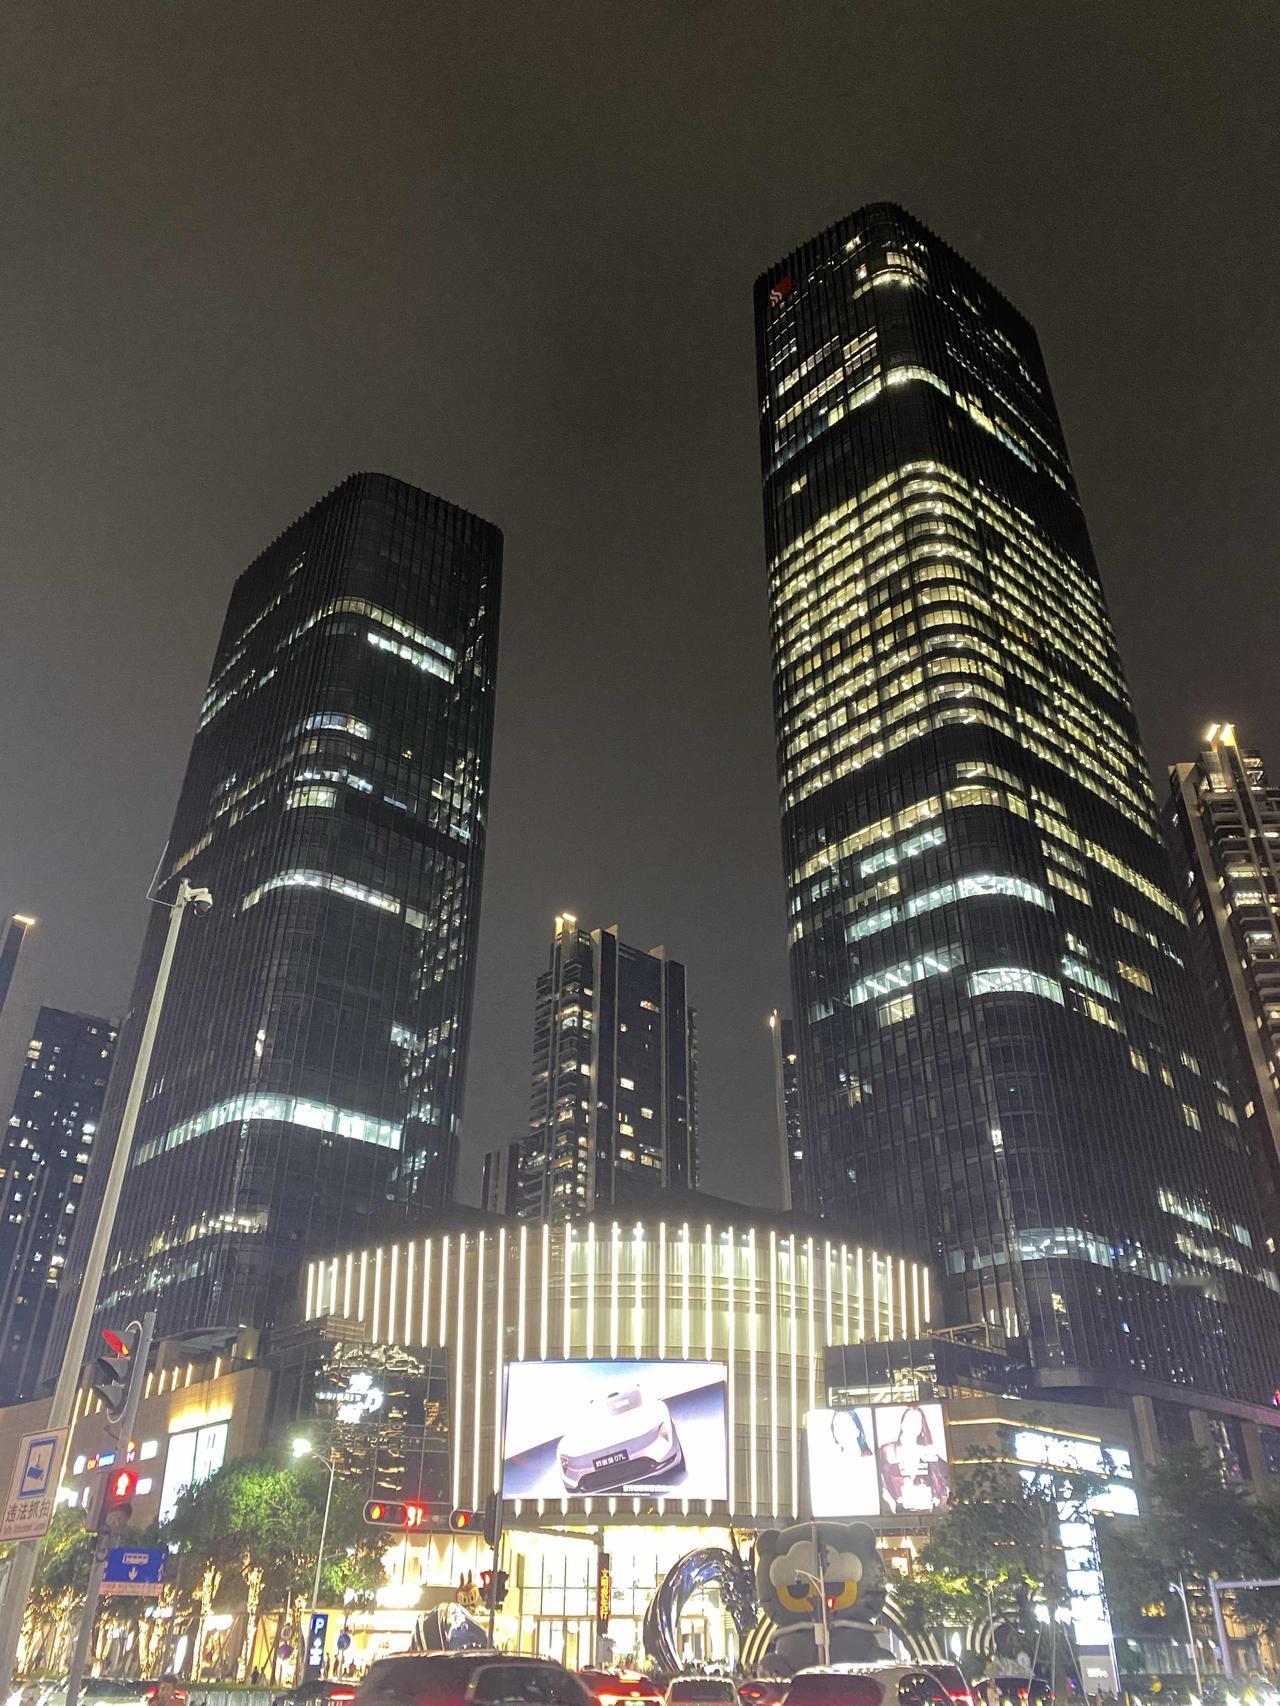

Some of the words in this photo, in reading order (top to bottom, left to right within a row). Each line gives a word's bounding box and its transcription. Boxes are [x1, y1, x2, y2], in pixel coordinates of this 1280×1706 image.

[6, 1500, 50, 1522] 违法抓拍
[314, 1617, 325, 1635] P
